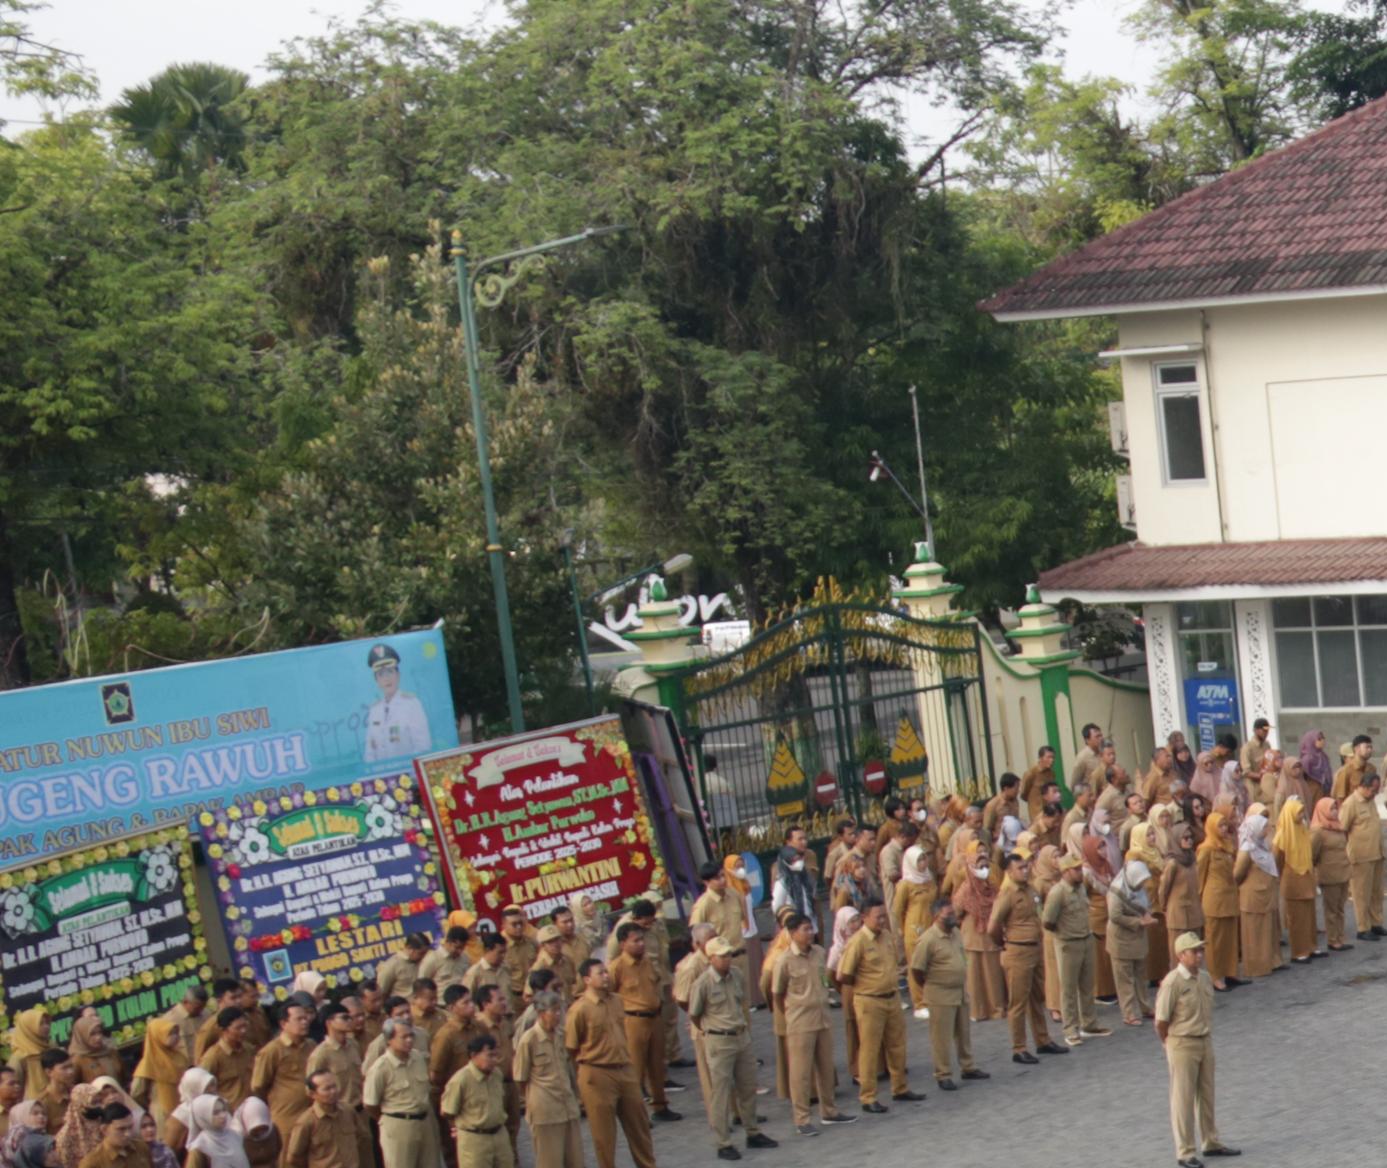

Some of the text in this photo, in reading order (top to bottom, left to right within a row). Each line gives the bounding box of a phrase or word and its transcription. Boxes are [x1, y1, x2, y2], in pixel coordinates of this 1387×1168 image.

[1196, 684, 1229, 699] ATM
[65, 725, 164, 762] NUWUN
[168, 717, 212, 745] IBU
[216, 706, 272, 737] SIWI
[146, 732, 310, 799] RAWUH
[43, 816, 126, 852] AGUNG
[315, 919, 404, 956] LESTARI
